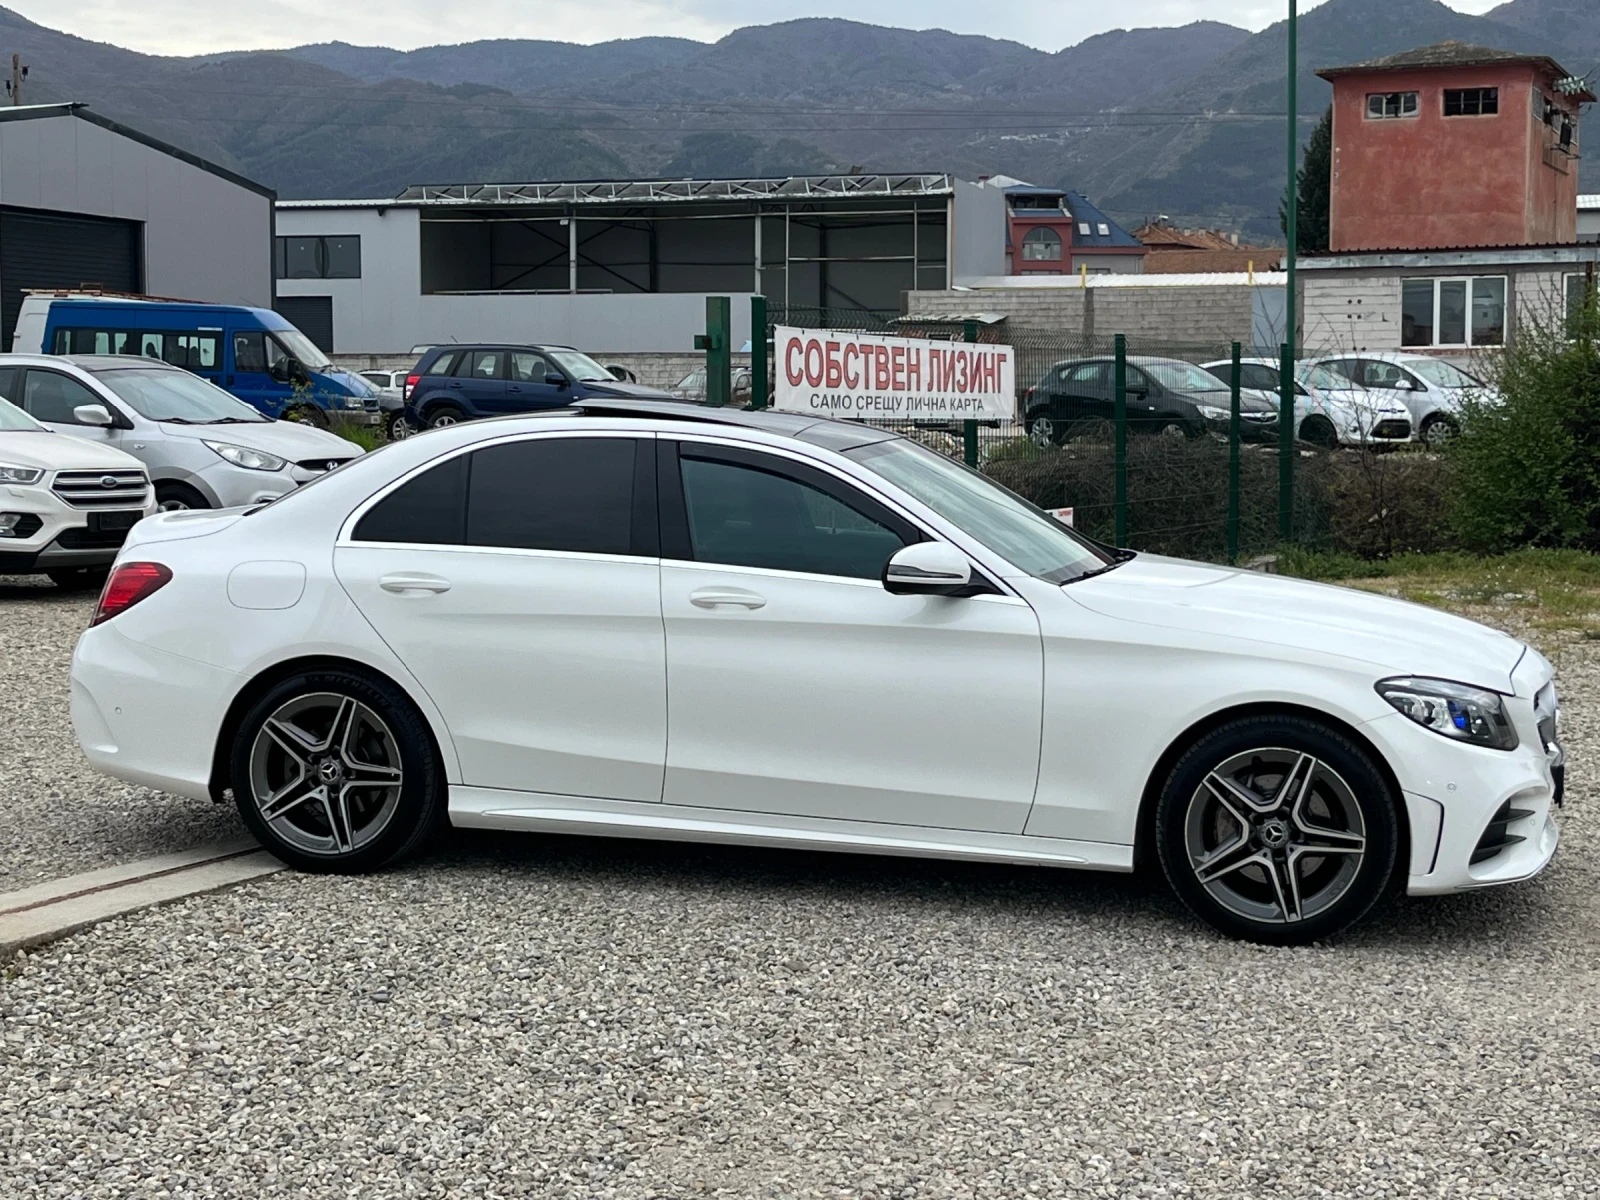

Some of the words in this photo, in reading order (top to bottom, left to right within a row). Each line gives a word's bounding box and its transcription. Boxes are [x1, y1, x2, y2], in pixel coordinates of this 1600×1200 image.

[785, 337, 920, 391] СОБСТВЕН
[927, 348, 1007, 394] ЛИЗИНГ
[810, 393, 851, 409] САМО
[856, 395, 902, 412] СРЕЩУ
[906, 397, 946, 411] ЛИЧНА
[950, 398, 984, 411] КАРТА
